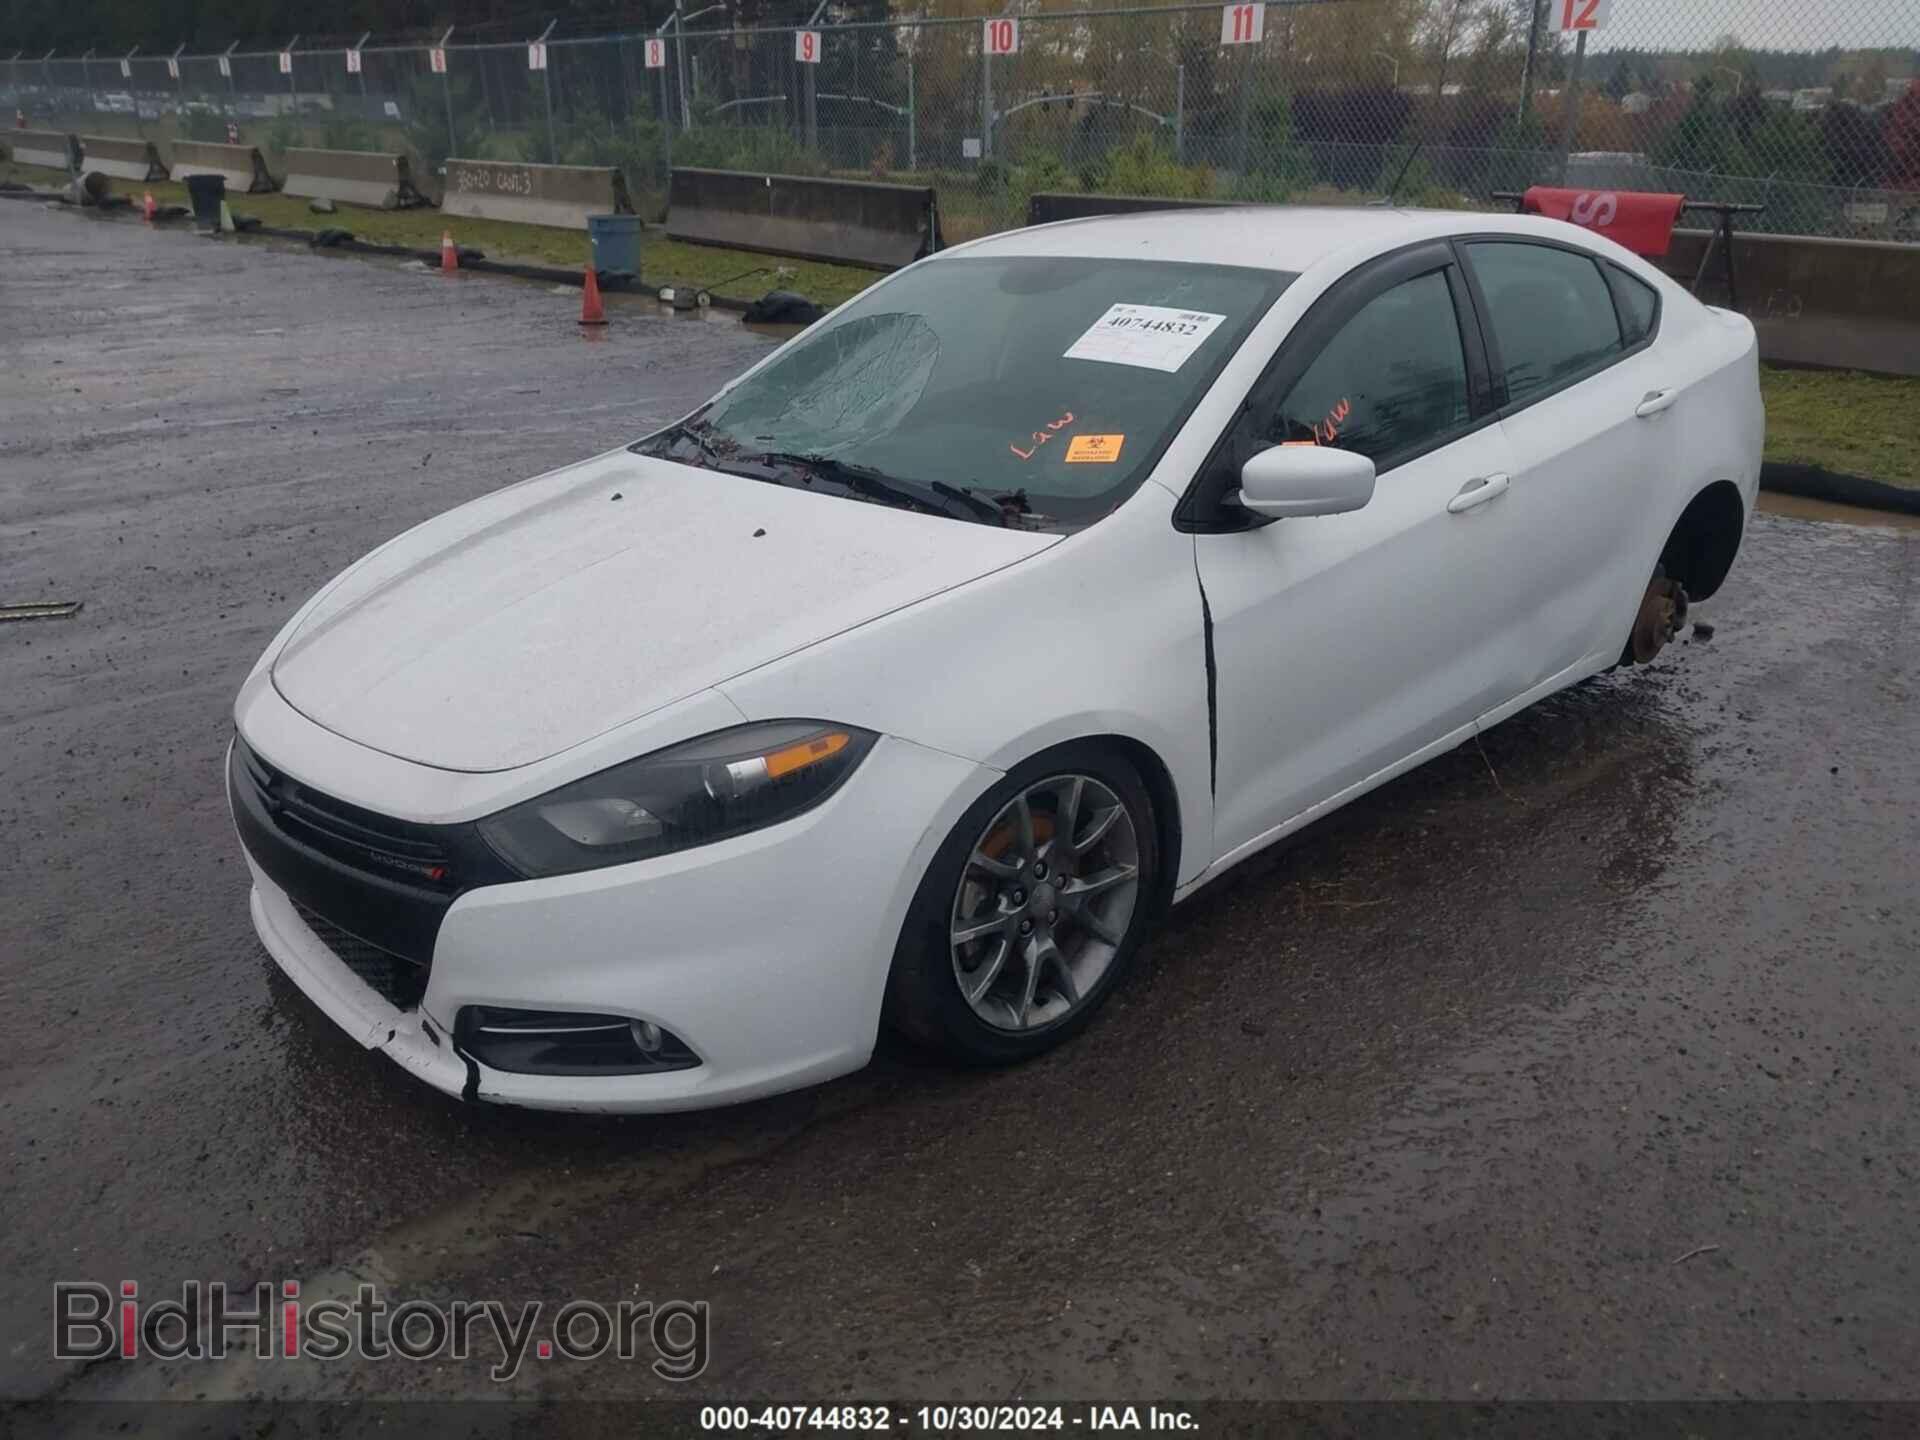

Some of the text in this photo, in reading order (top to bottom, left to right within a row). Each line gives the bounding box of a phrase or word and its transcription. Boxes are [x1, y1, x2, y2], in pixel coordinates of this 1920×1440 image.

[1233, 6, 1254, 41] 11
[1562, 0, 1599, 29] 12
[803, 33, 813, 59] 9
[990, 21, 1012, 50] 10
[534, 44, 541, 66] 7
[650, 42, 659, 65] 8
[1107, 316, 1198, 336] 40744832
